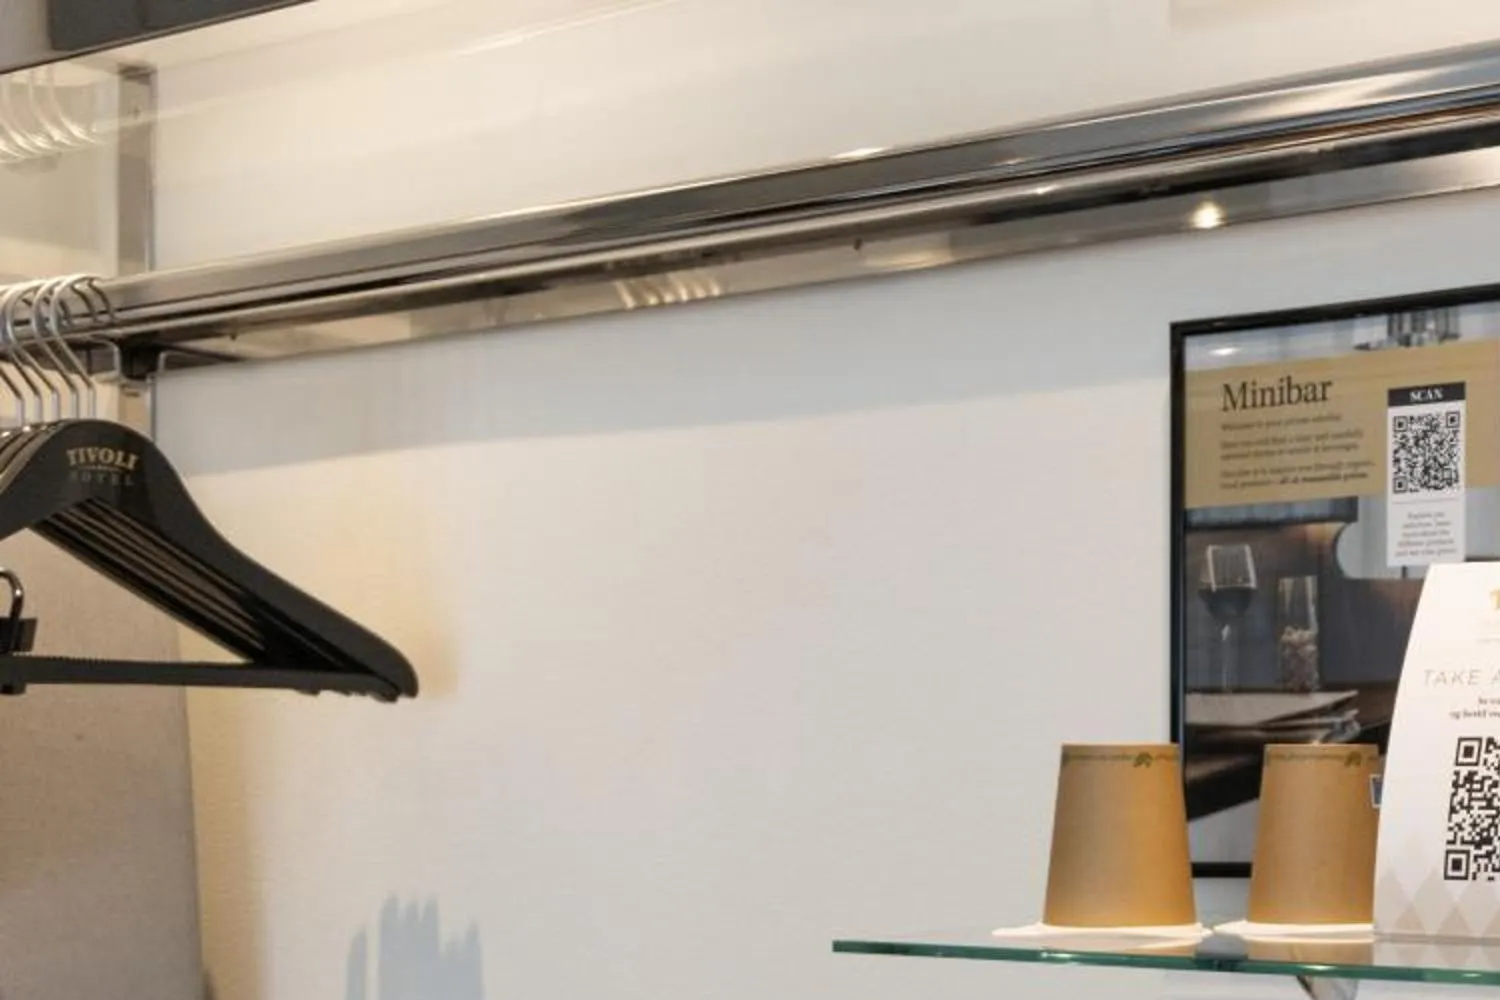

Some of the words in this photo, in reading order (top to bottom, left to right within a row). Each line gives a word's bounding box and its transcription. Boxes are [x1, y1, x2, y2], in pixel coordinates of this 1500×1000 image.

[1222, 375, 1333, 412] Minibar
[1409, 387, 1443, 402] SCAN
[66, 447, 139, 471] TIVOLI
[1424, 667, 1482, 687] TAKE
